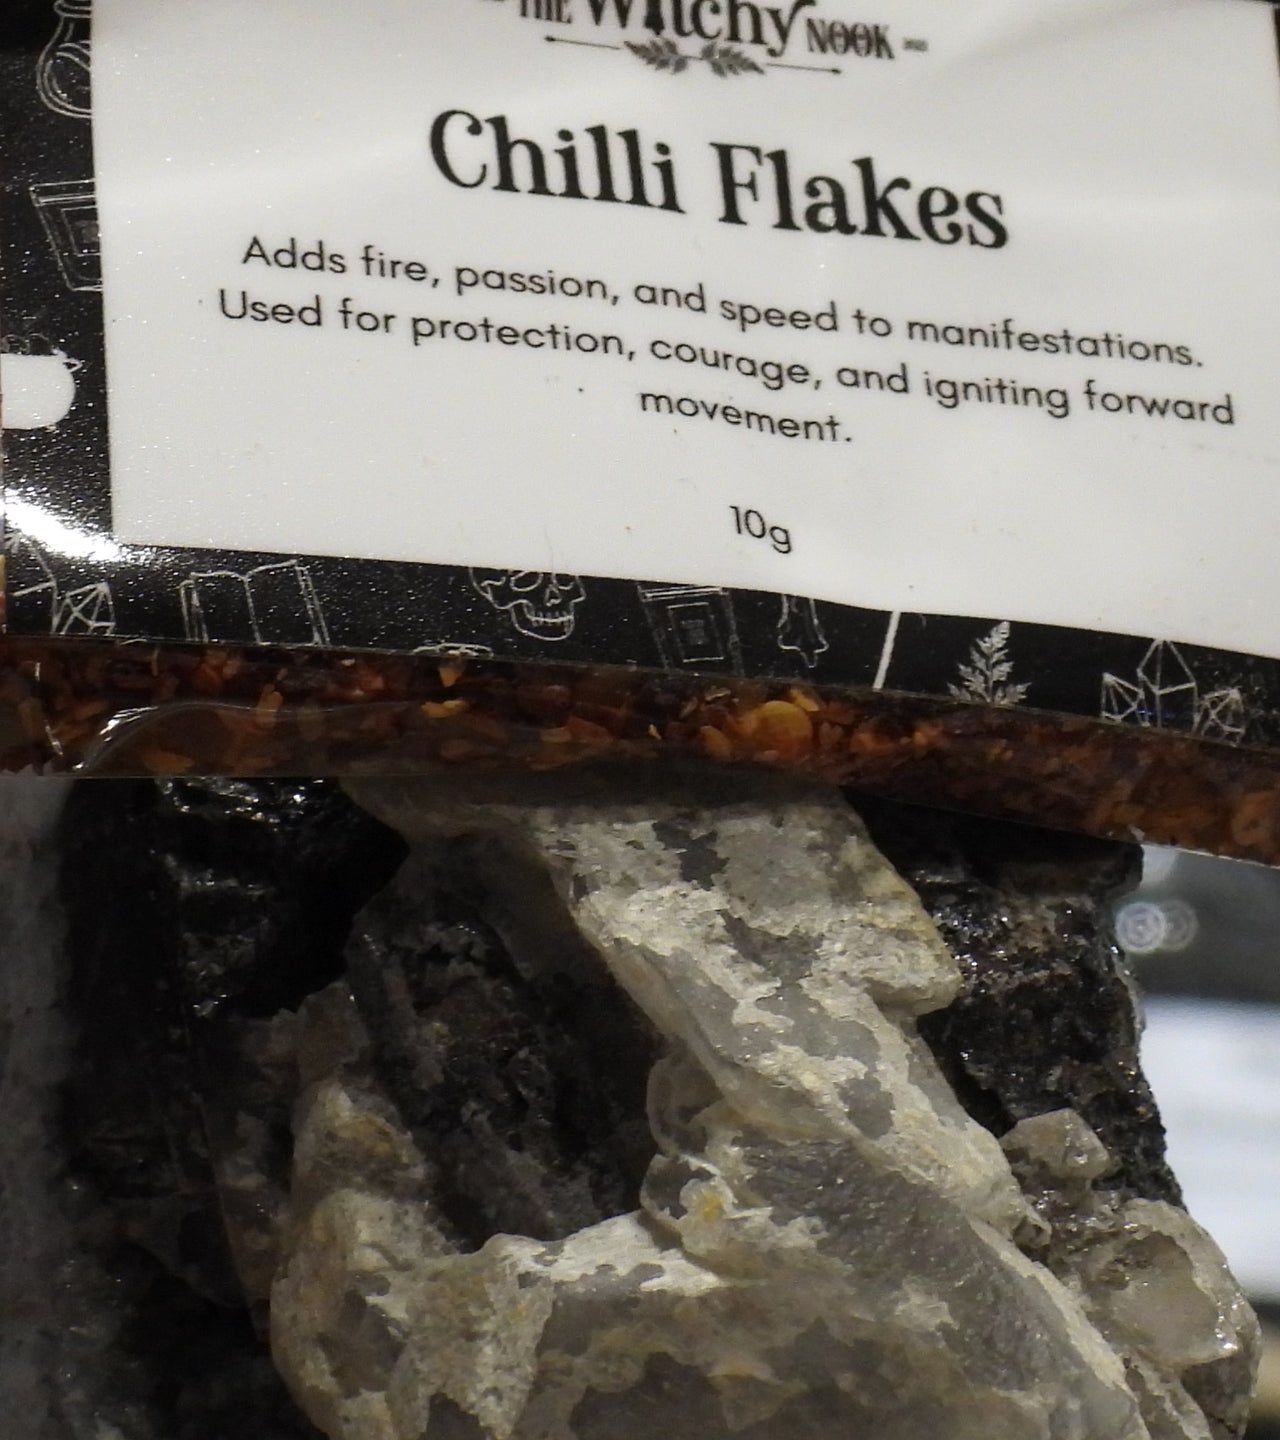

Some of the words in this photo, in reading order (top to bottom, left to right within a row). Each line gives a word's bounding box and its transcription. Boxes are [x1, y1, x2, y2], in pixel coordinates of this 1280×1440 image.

[805, 17, 896, 61] NOOK
[428, 108, 687, 216] Chilli
[708, 141, 1010, 251] Flakes
[241, 234, 348, 275] Adds
[359, 244, 441, 289] fire,
[454, 266, 621, 307] passion,
[632, 282, 708, 315] and
[719, 299, 840, 334] speed
[850, 308, 894, 338] to
[906, 317, 1204, 371] manifestations.
[218, 287, 324, 328] Used
[337, 296, 398, 334] for
[410, 316, 637, 361] protection,
[649, 339, 823, 391] courage,
[835, 362, 911, 395] and
[923, 370, 1072, 420] igniting
[1082, 378, 1236, 426] forward
[638, 388, 853, 443] movement.
[728, 504, 793, 555] 10g
